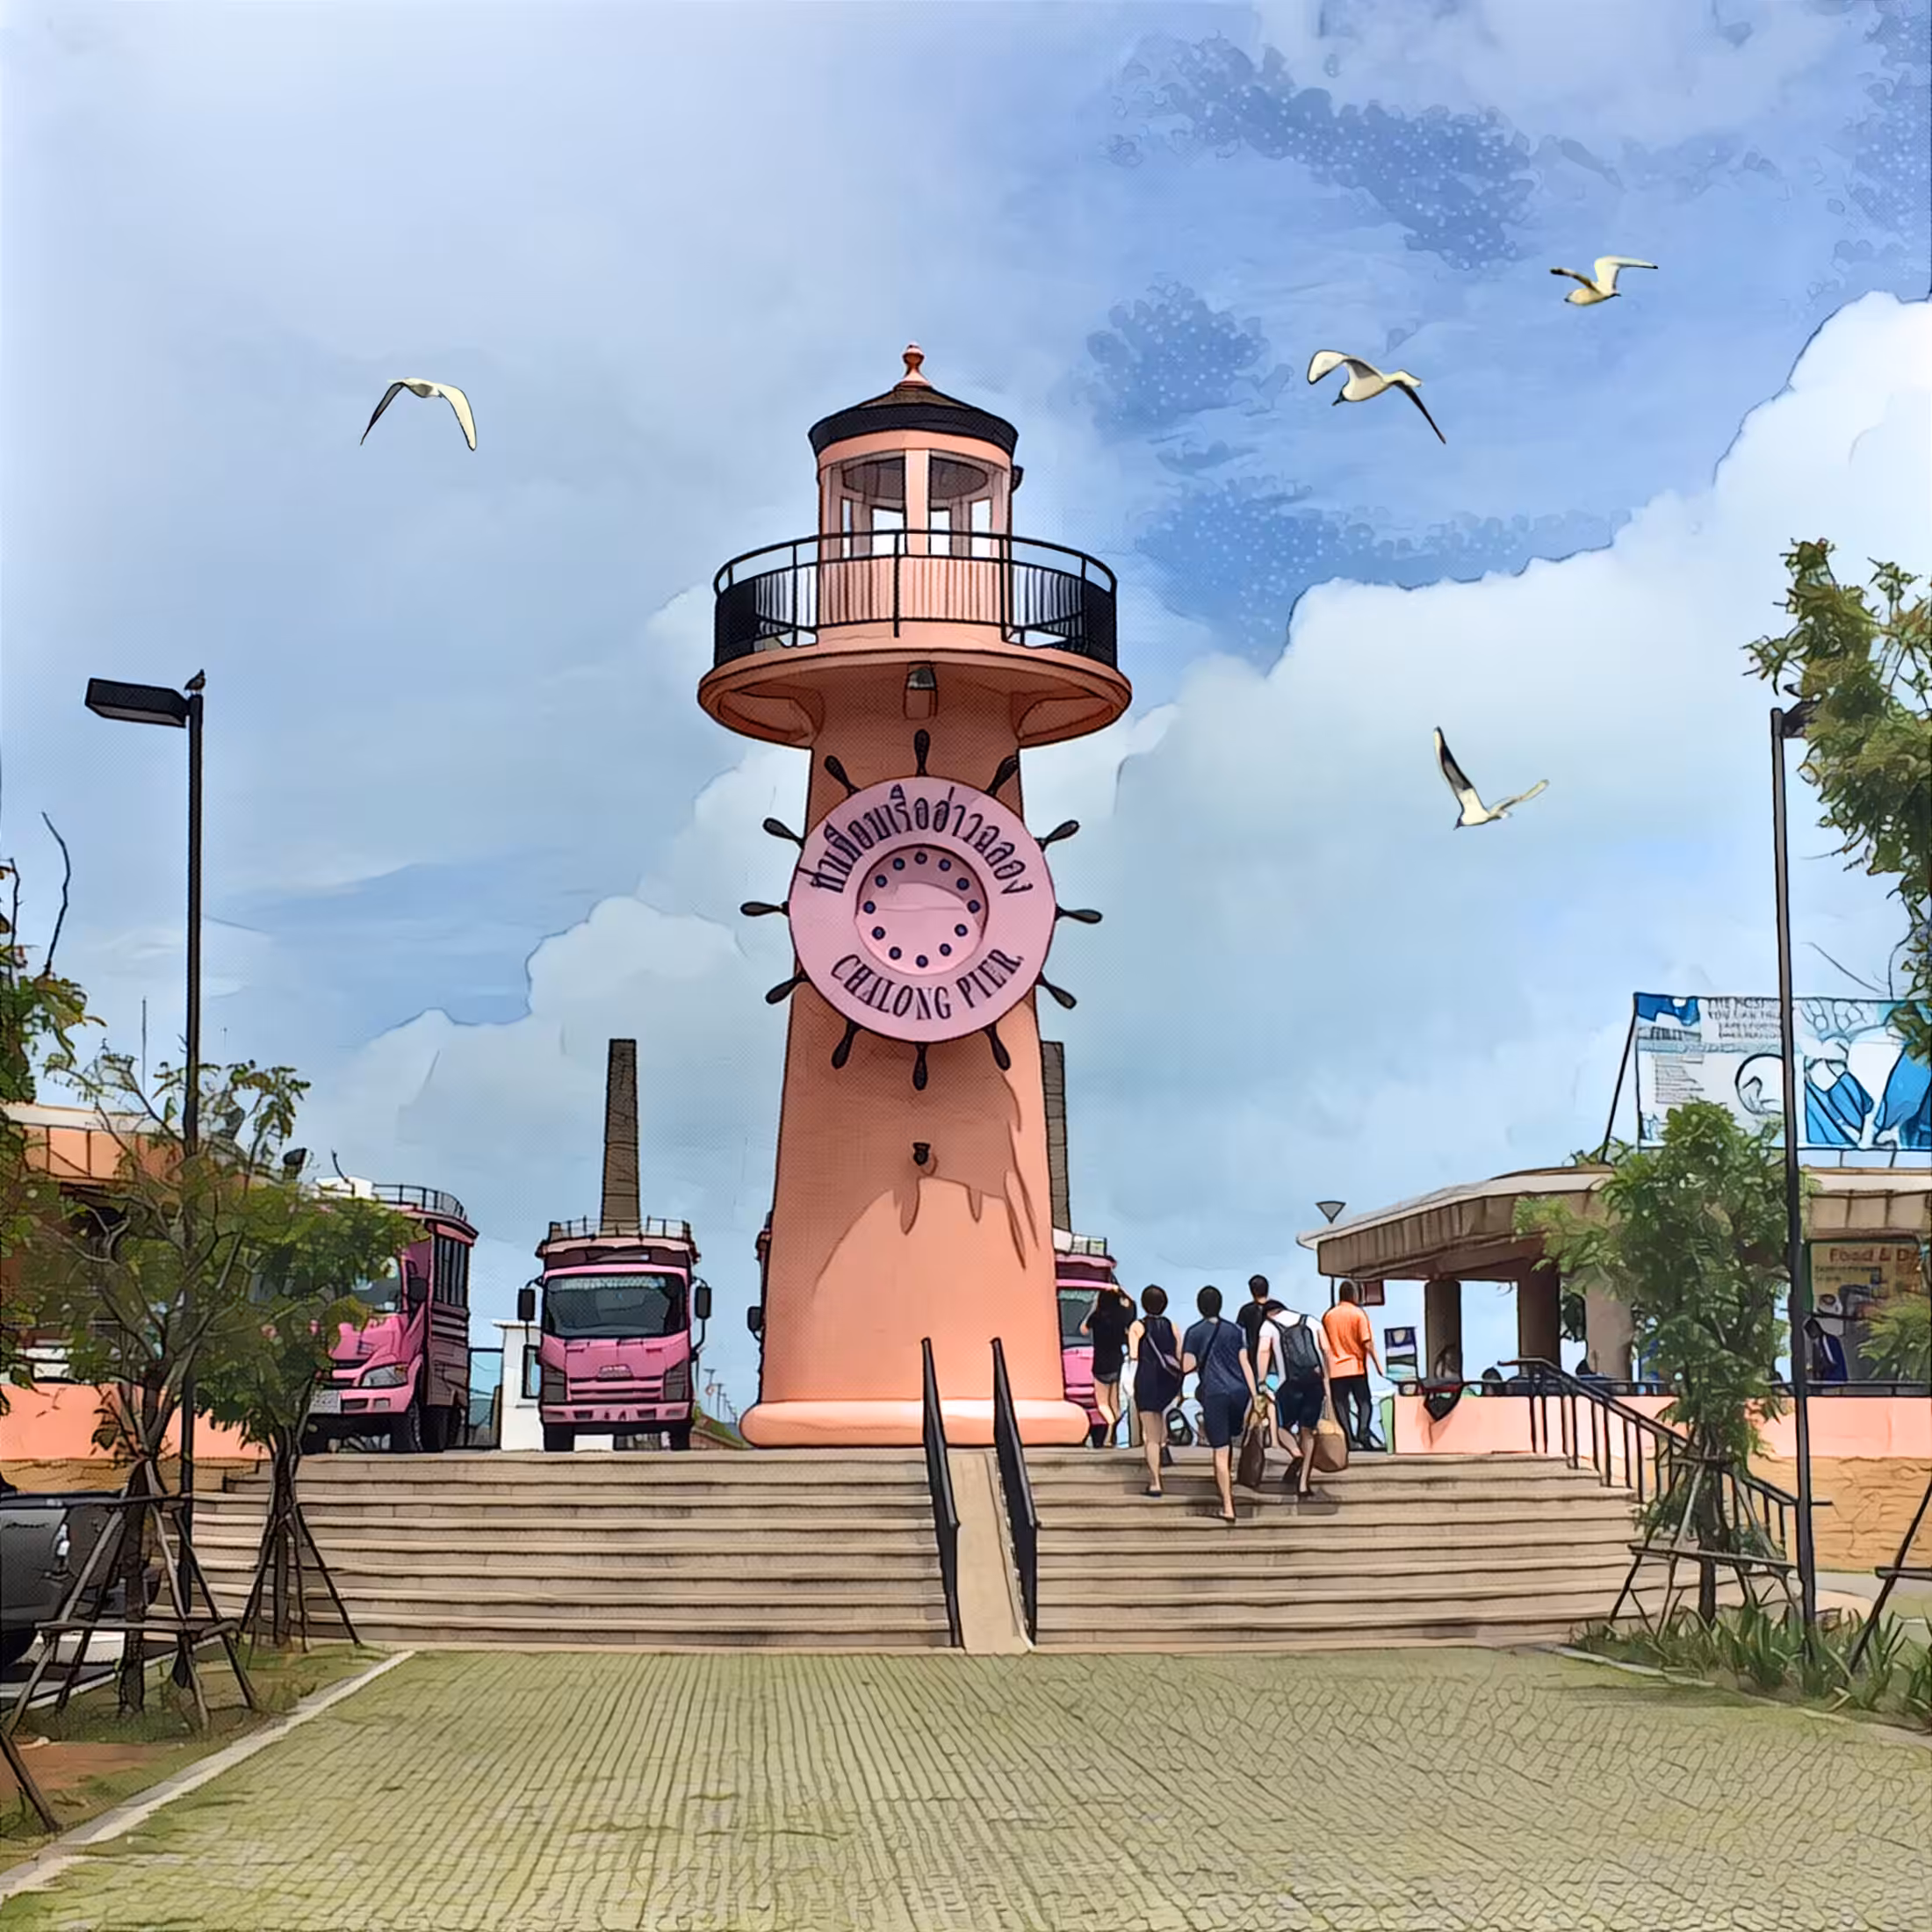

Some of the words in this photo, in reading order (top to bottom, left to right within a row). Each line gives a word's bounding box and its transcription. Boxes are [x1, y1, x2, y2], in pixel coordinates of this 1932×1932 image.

[830, 953, 952, 1020] CHALONG
[955, 948, 1025, 1009] PIER
[1829, 1247, 1874, 1263] Food
